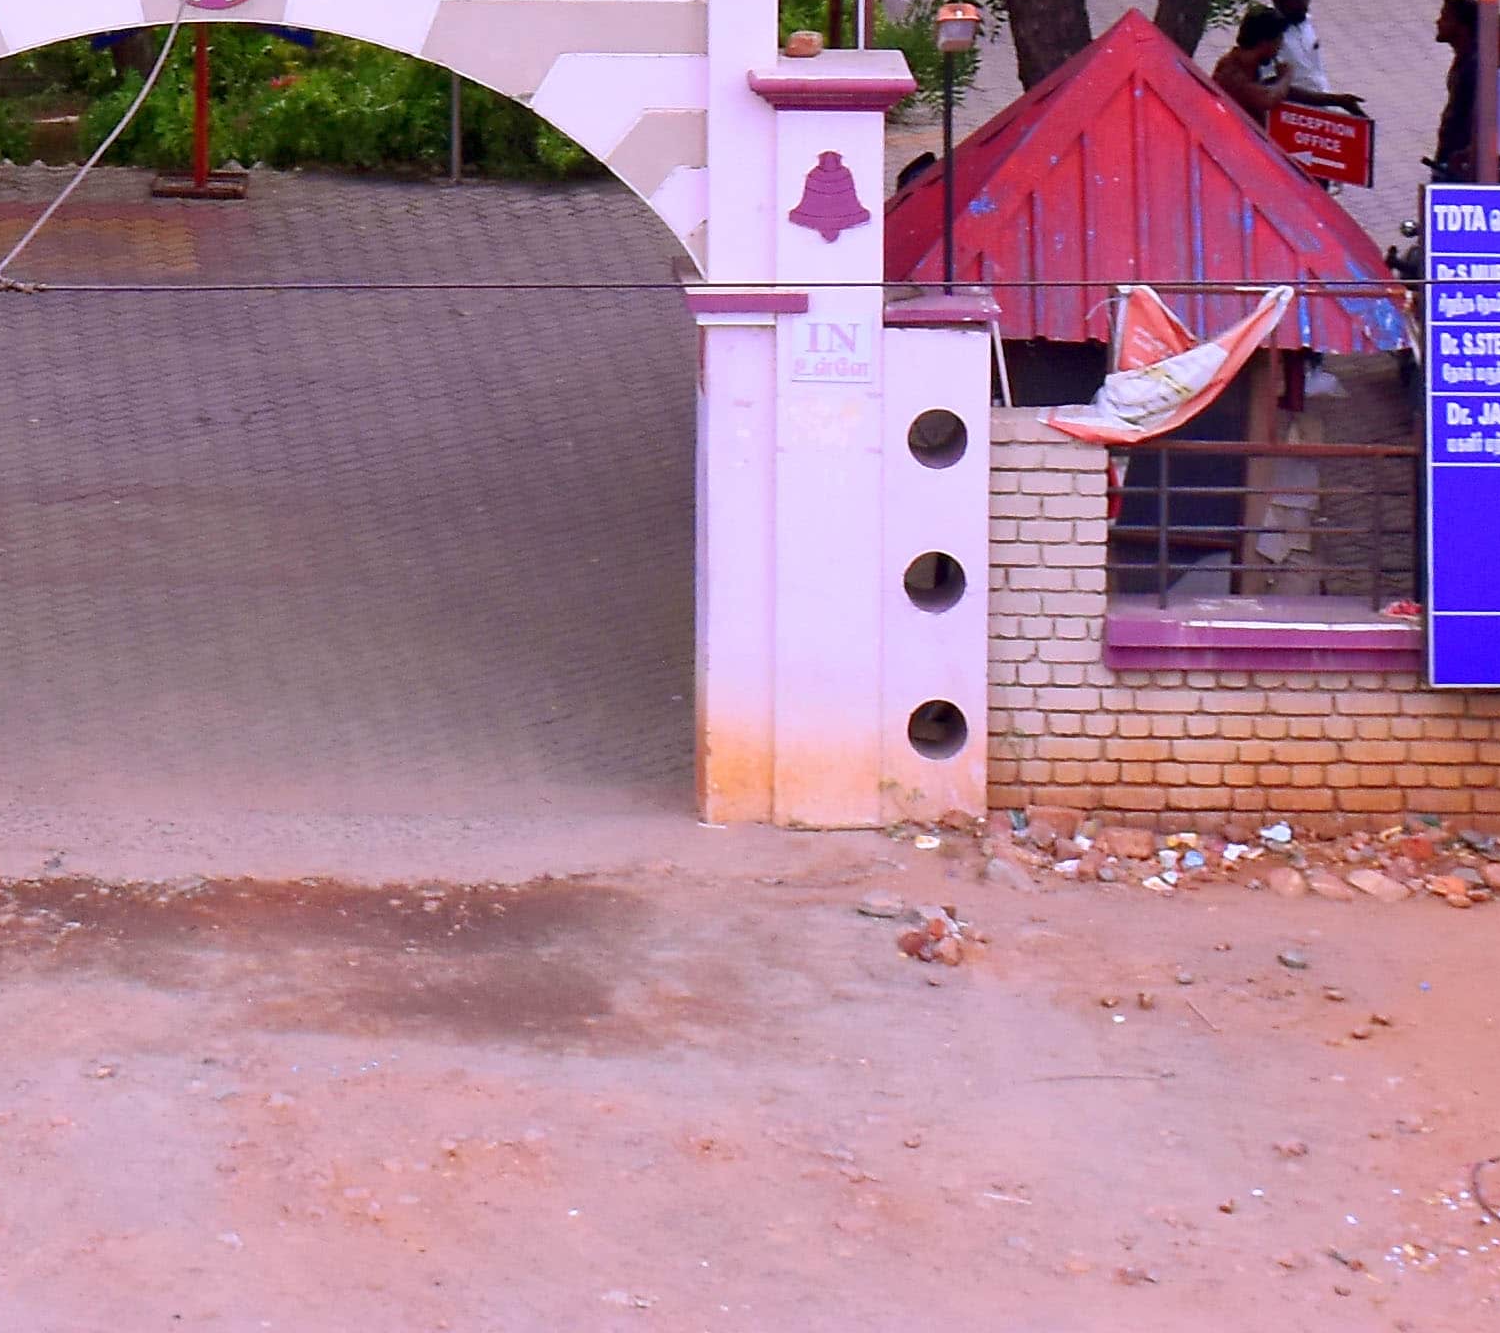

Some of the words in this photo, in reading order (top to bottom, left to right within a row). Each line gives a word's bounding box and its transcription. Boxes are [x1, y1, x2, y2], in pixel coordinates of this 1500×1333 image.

[1280, 111, 1356, 138] RECEPTION
[1294, 131, 1342, 153] OFFICE
[1434, 205, 1487, 232] TDTA
[805, 322, 862, 353] IN
